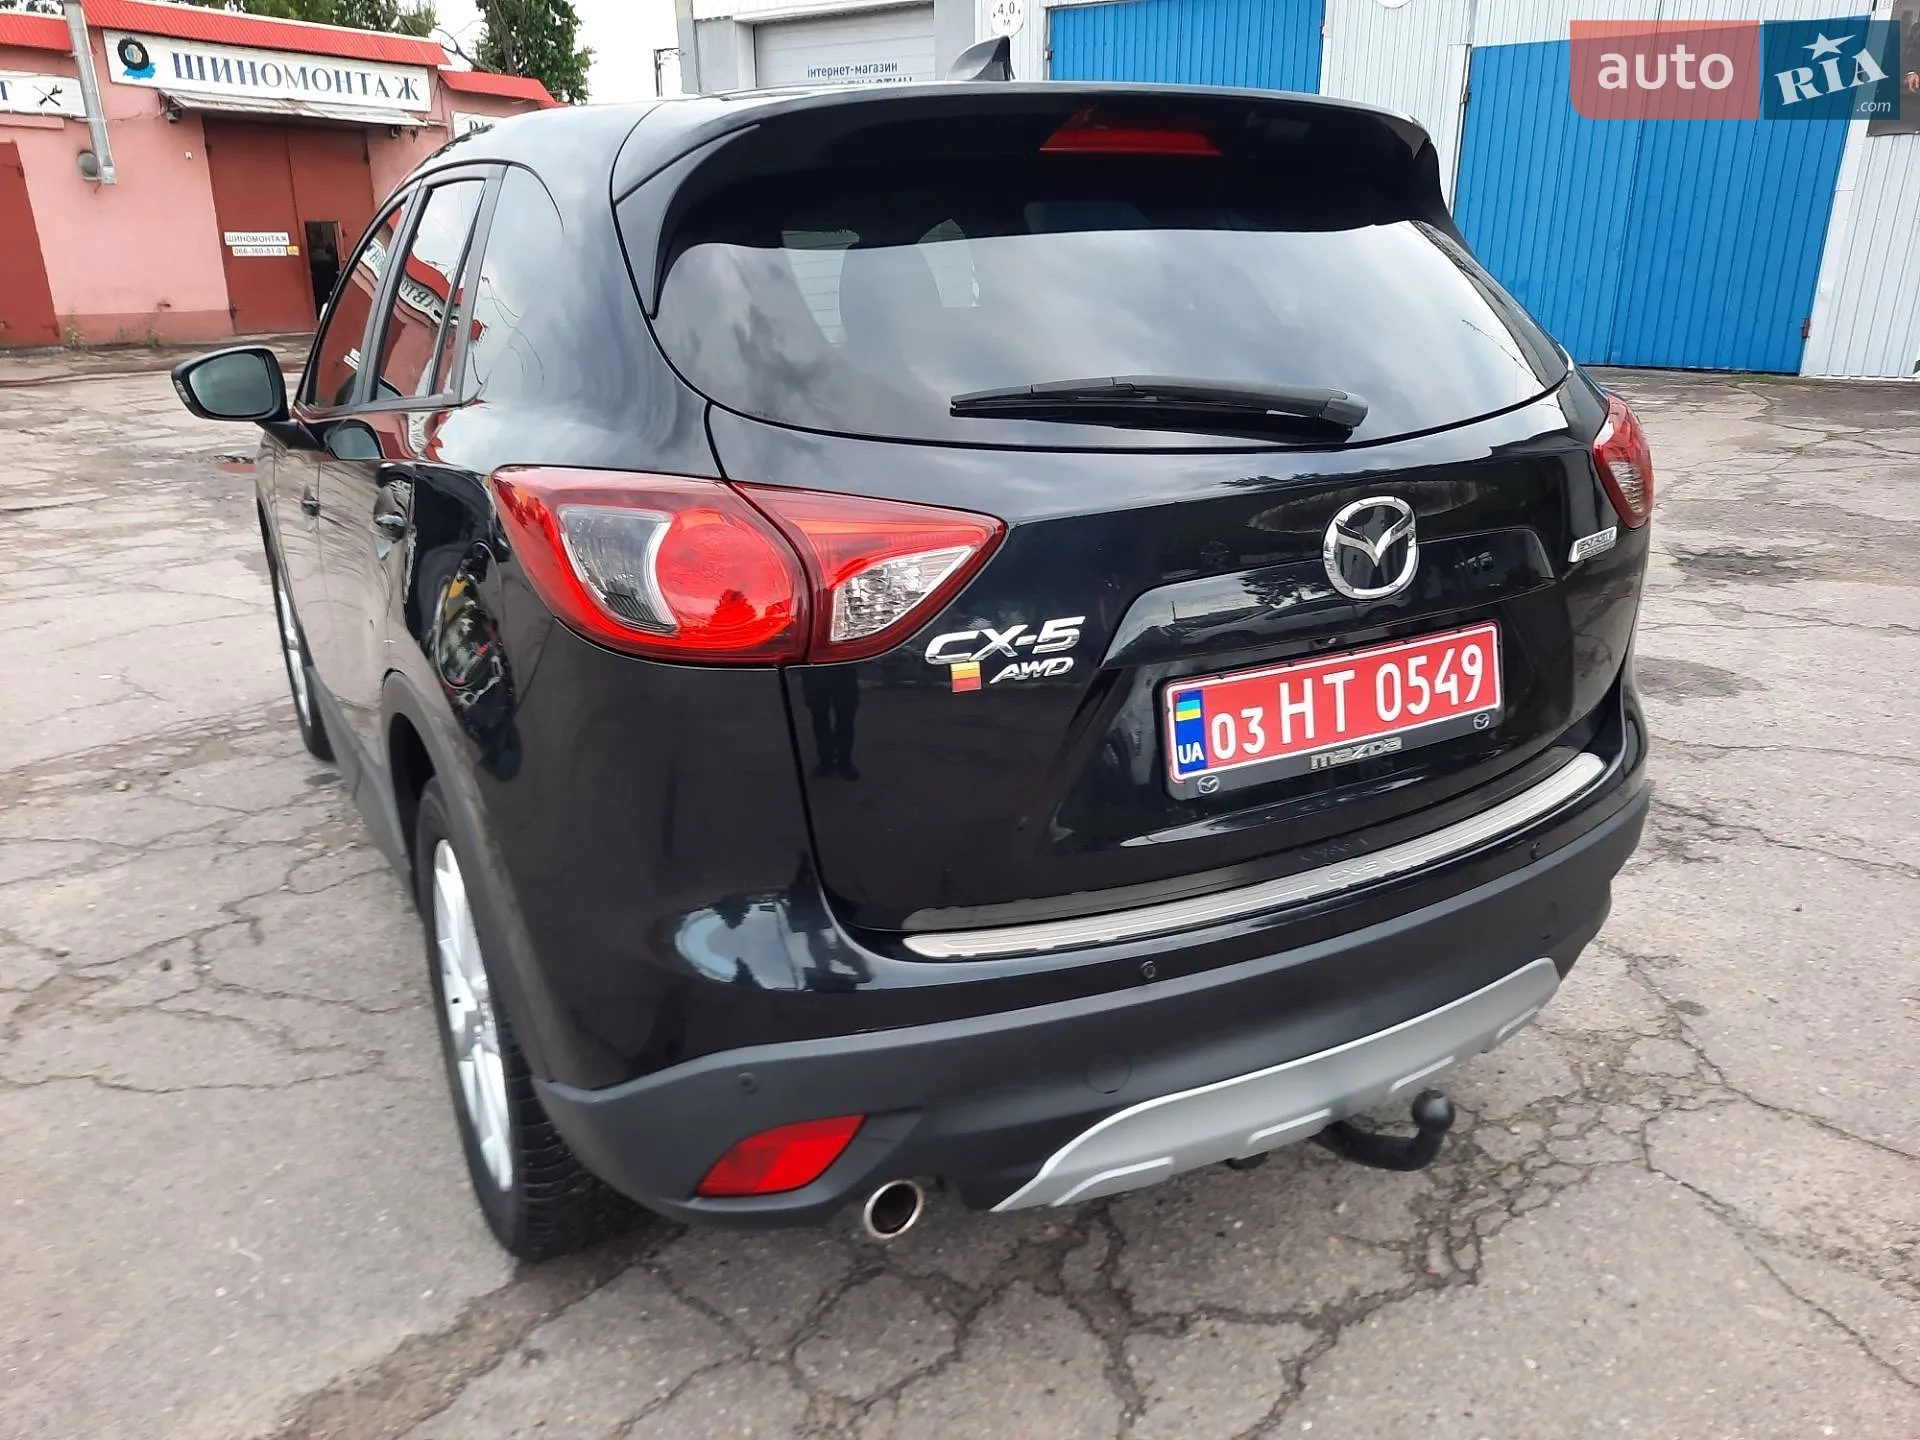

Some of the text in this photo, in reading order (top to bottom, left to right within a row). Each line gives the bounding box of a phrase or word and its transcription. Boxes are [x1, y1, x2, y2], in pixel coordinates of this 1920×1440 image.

[170, 52, 420, 101] ШИНОМОНТАЖ
[807, 62, 898, 79] інтернет-магазин
[924, 616, 1086, 665] CX-5
[989, 656, 1074, 684] AWD
[1178, 743, 1204, 765] UA
[1211, 706, 1265, 760] 03
[1376, 644, 1484, 723] 0549
